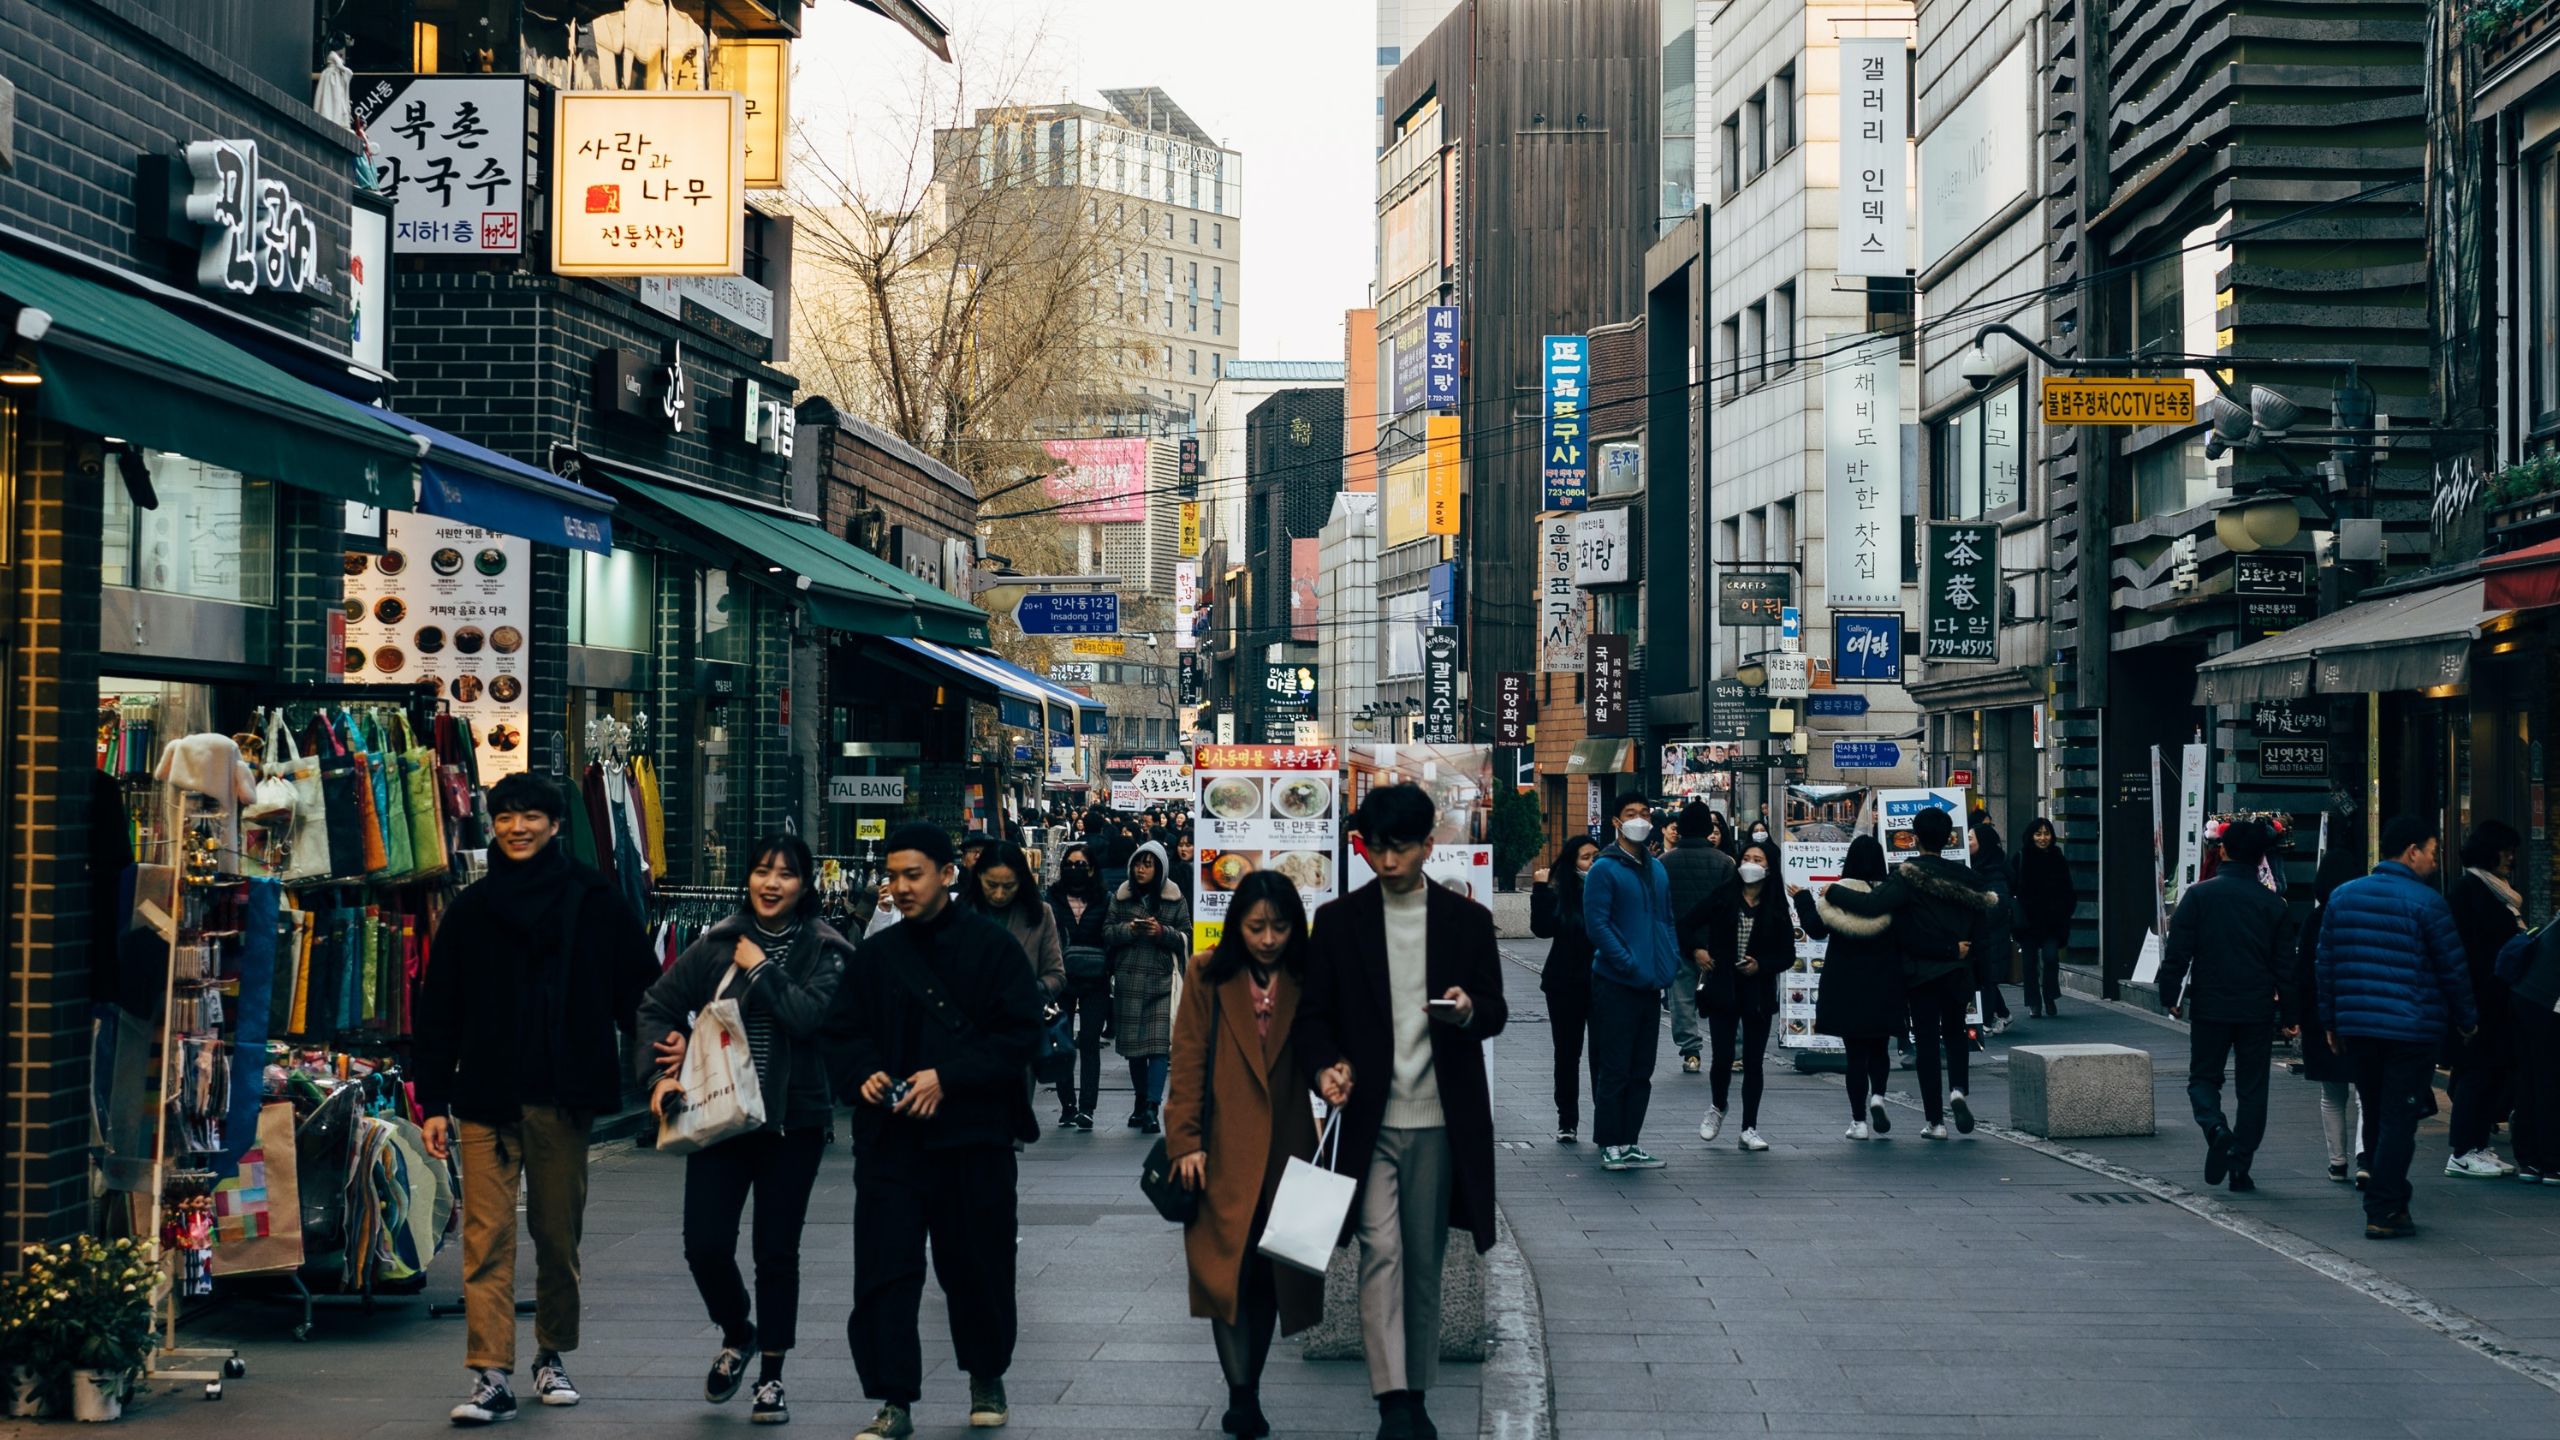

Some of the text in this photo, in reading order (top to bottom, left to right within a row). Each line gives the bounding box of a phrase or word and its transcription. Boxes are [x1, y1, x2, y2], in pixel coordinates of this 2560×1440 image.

[355, 80, 394, 120] 인사동
[391, 100, 489, 150] 북촌
[1860, 56, 1885, 254] 갤러리 인덱스
[1968, 125, 2001, 185] INDE
[642, 179, 712, 206] 나무
[397, 220, 474, 244] 지하1층
[602, 224, 684, 249] 전통찻집
[1431, 310, 1455, 392] 세종화랑
[1847, 459, 1879, 510] 반한
[1547, 488, 1585, 497] 723-0804
[435, 528, 462, 539] 시원한
[465, 528, 482, 539] 여름
[1854, 521, 1880, 580] 찻집
[2239, 568, 2302, 583] 고요한 소리
[1727, 581, 1767, 590] CRAFTS
[1051, 597, 1114, 610] 인사동12길
[1833, 594, 1897, 602] TEAHOUSE
[430, 606, 507, 617] 커피와 음료 & 다과
[1741, 597, 1781, 620] 아원
[2249, 604, 2296, 614] 한옥전통찻집
[1050, 612, 1114, 621] Insadong 12-gil
[1846, 624, 1869, 633] Gallery
[1934, 616, 1989, 634] 다암
[1929, 639, 1993, 655] 739-8595
[1573, 652, 1585, 660] 2F
[1269, 667, 1297, 682] 인사동
[1887, 664, 1896, 675] 1F
[1266, 677, 1298, 698] 마루
[1431, 661, 1451, 714] 칼국수
[1595, 646, 1608, 723] 국제자수원
[1771, 677, 1806, 690] 10:00-22:00
[1716, 686, 1745, 698] 인사동
[1503, 677, 1519, 738] 한양화랑
[1430, 713, 1453, 723] 만두
[1430, 724, 1453, 733] 보쌈
[1835, 744, 1875, 753] 인사동11길
[2265, 748, 2324, 763] 신옛찻집
[1197, 749, 1338, 769] 인사동명물 북촌칼국수
[830, 783, 902, 798] TAL BANG
[1140, 777, 1190, 792] 북촌손만두
[861, 825, 881, 834] 50%
[1213, 821, 1251, 834] 칼국수
[1788, 856, 1833, 869] 47번가
